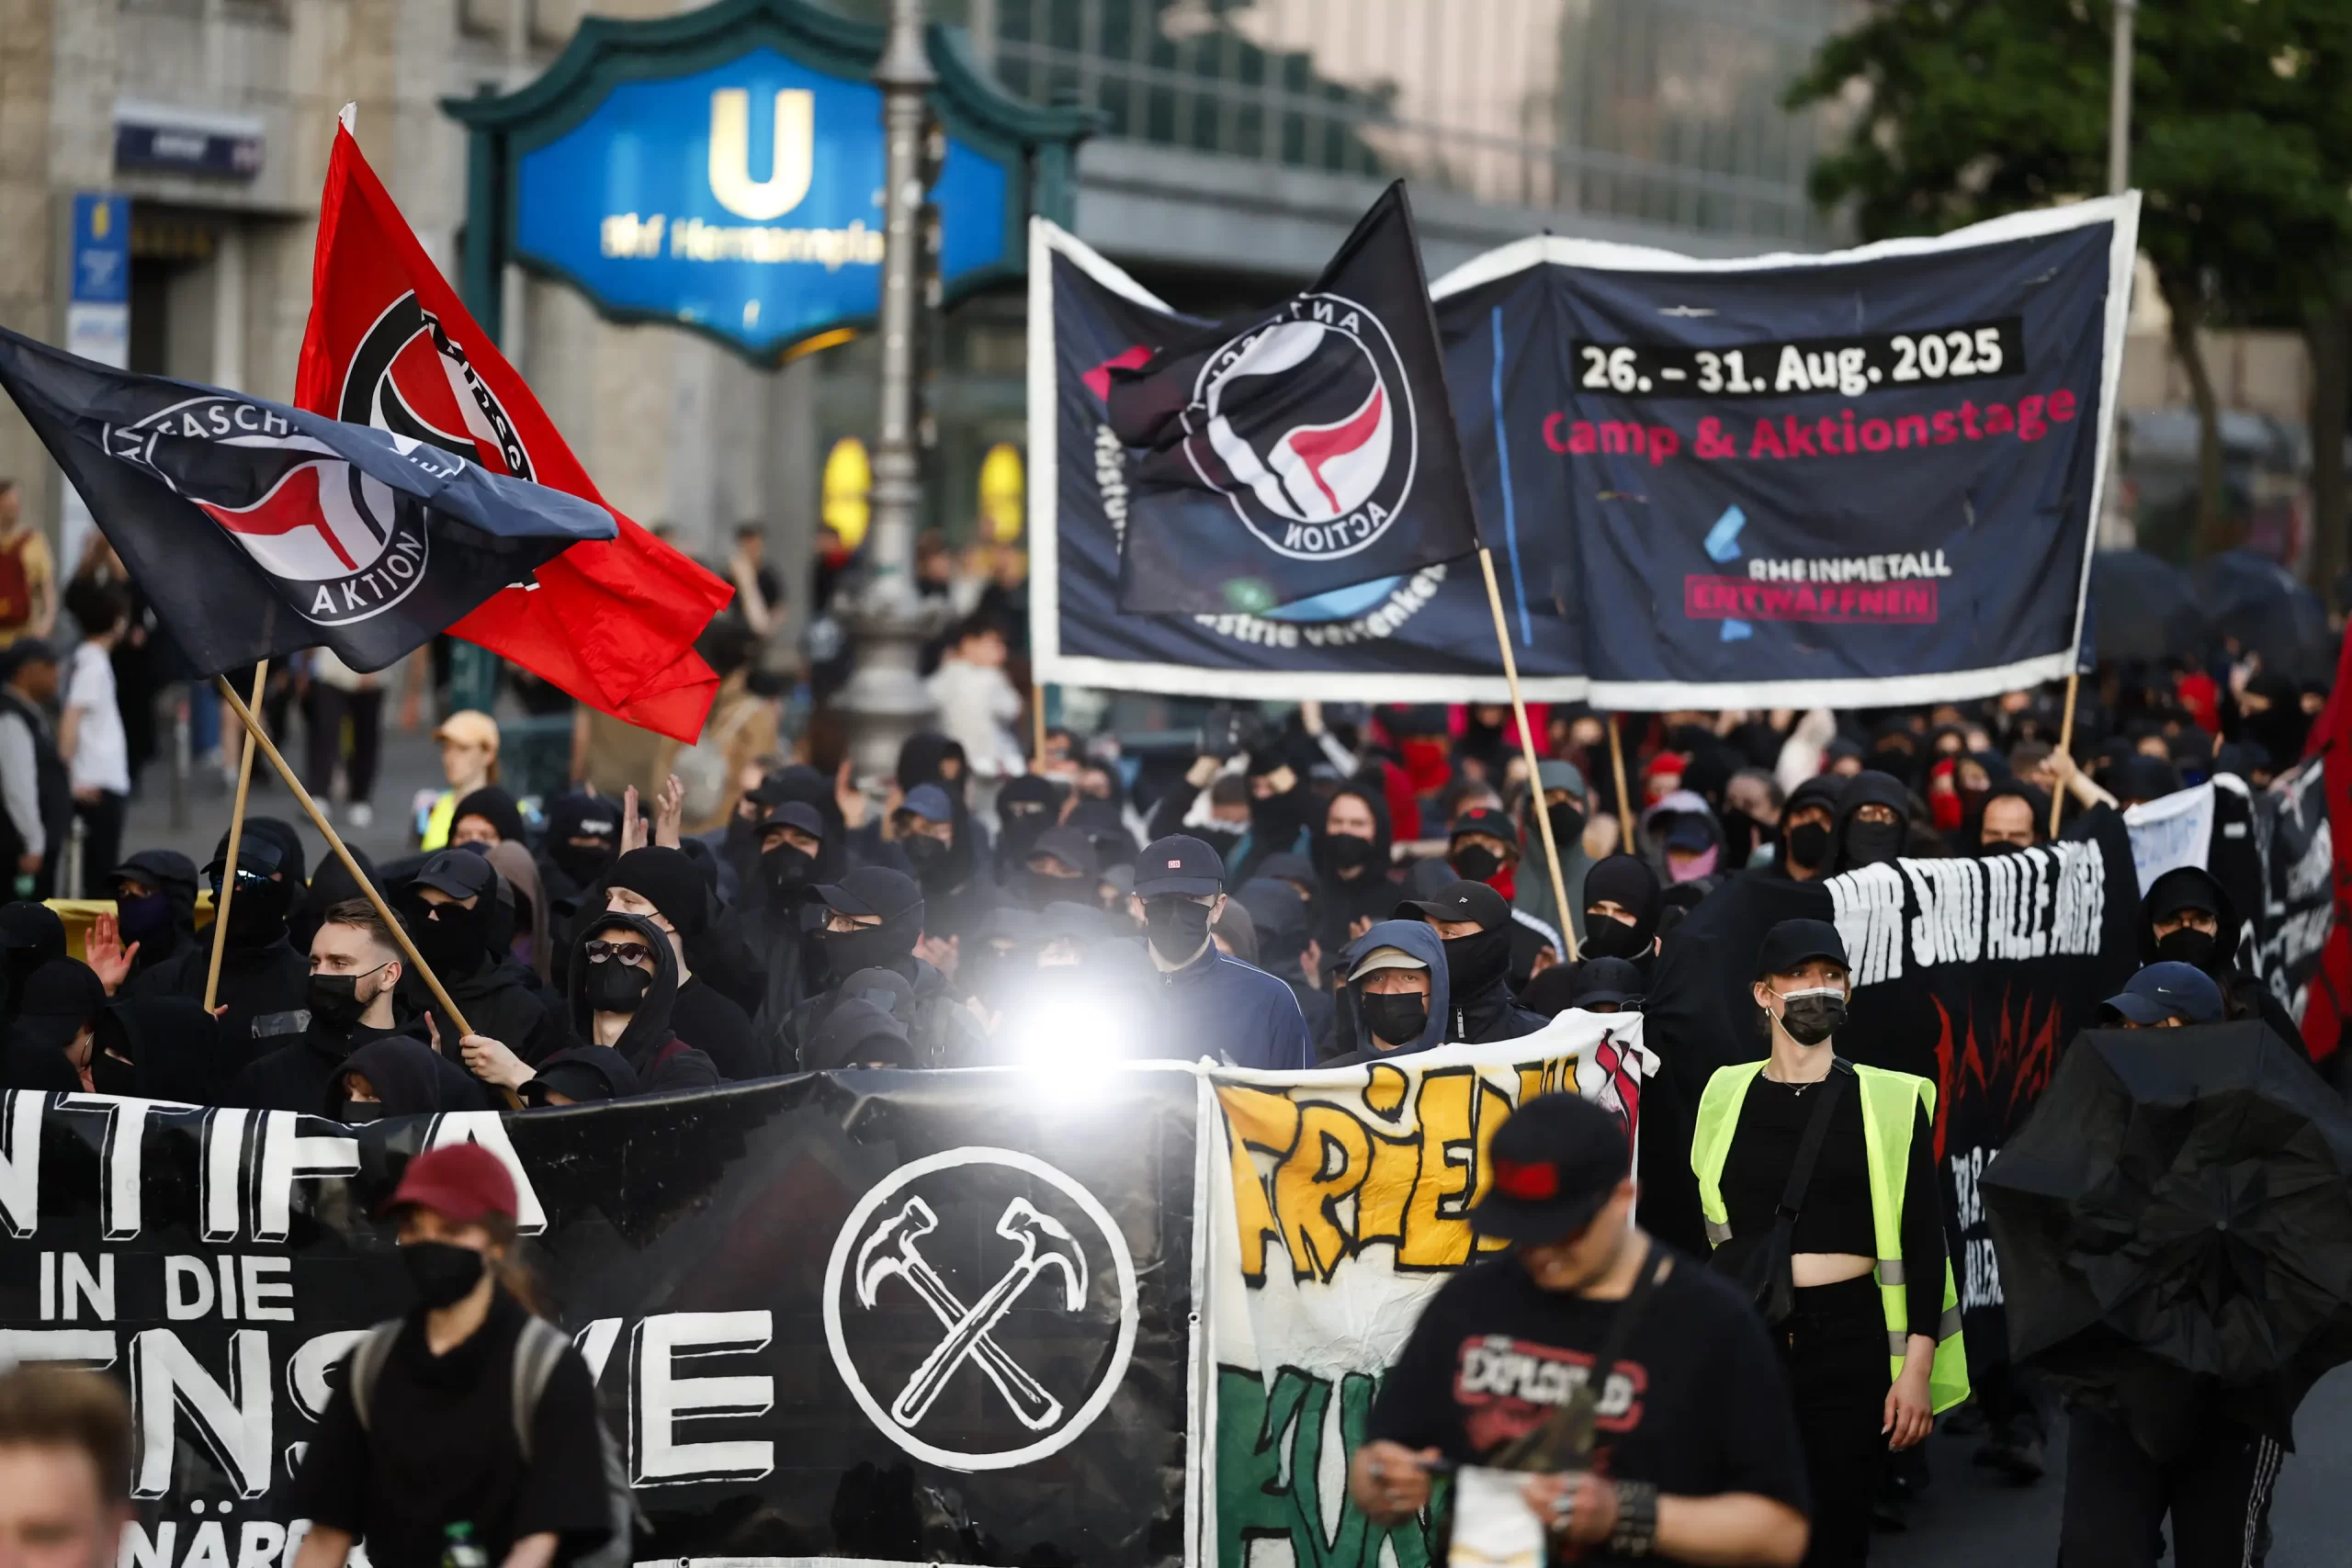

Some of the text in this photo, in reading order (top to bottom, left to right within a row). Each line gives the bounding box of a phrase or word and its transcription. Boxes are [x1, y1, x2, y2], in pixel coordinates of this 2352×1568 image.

[708, 88, 815, 220] U
[1581, 345, 1652, 393] 26.
[1694, 350, 1767, 393] 31.
[1774, 345, 1883, 397] Aug.
[1890, 327, 2004, 382] 2025
[1543, 388, 2076, 466] Camp & Aktionstage
[311, 531, 423, 615] AKTION
[1692, 583, 1929, 616] ENTWAFFNEN
[1748, 548, 1952, 583] RHEINMETALL
[1979, 846, 2049, 961] ALLE
[40, 1251, 294, 1321] IN DIE
